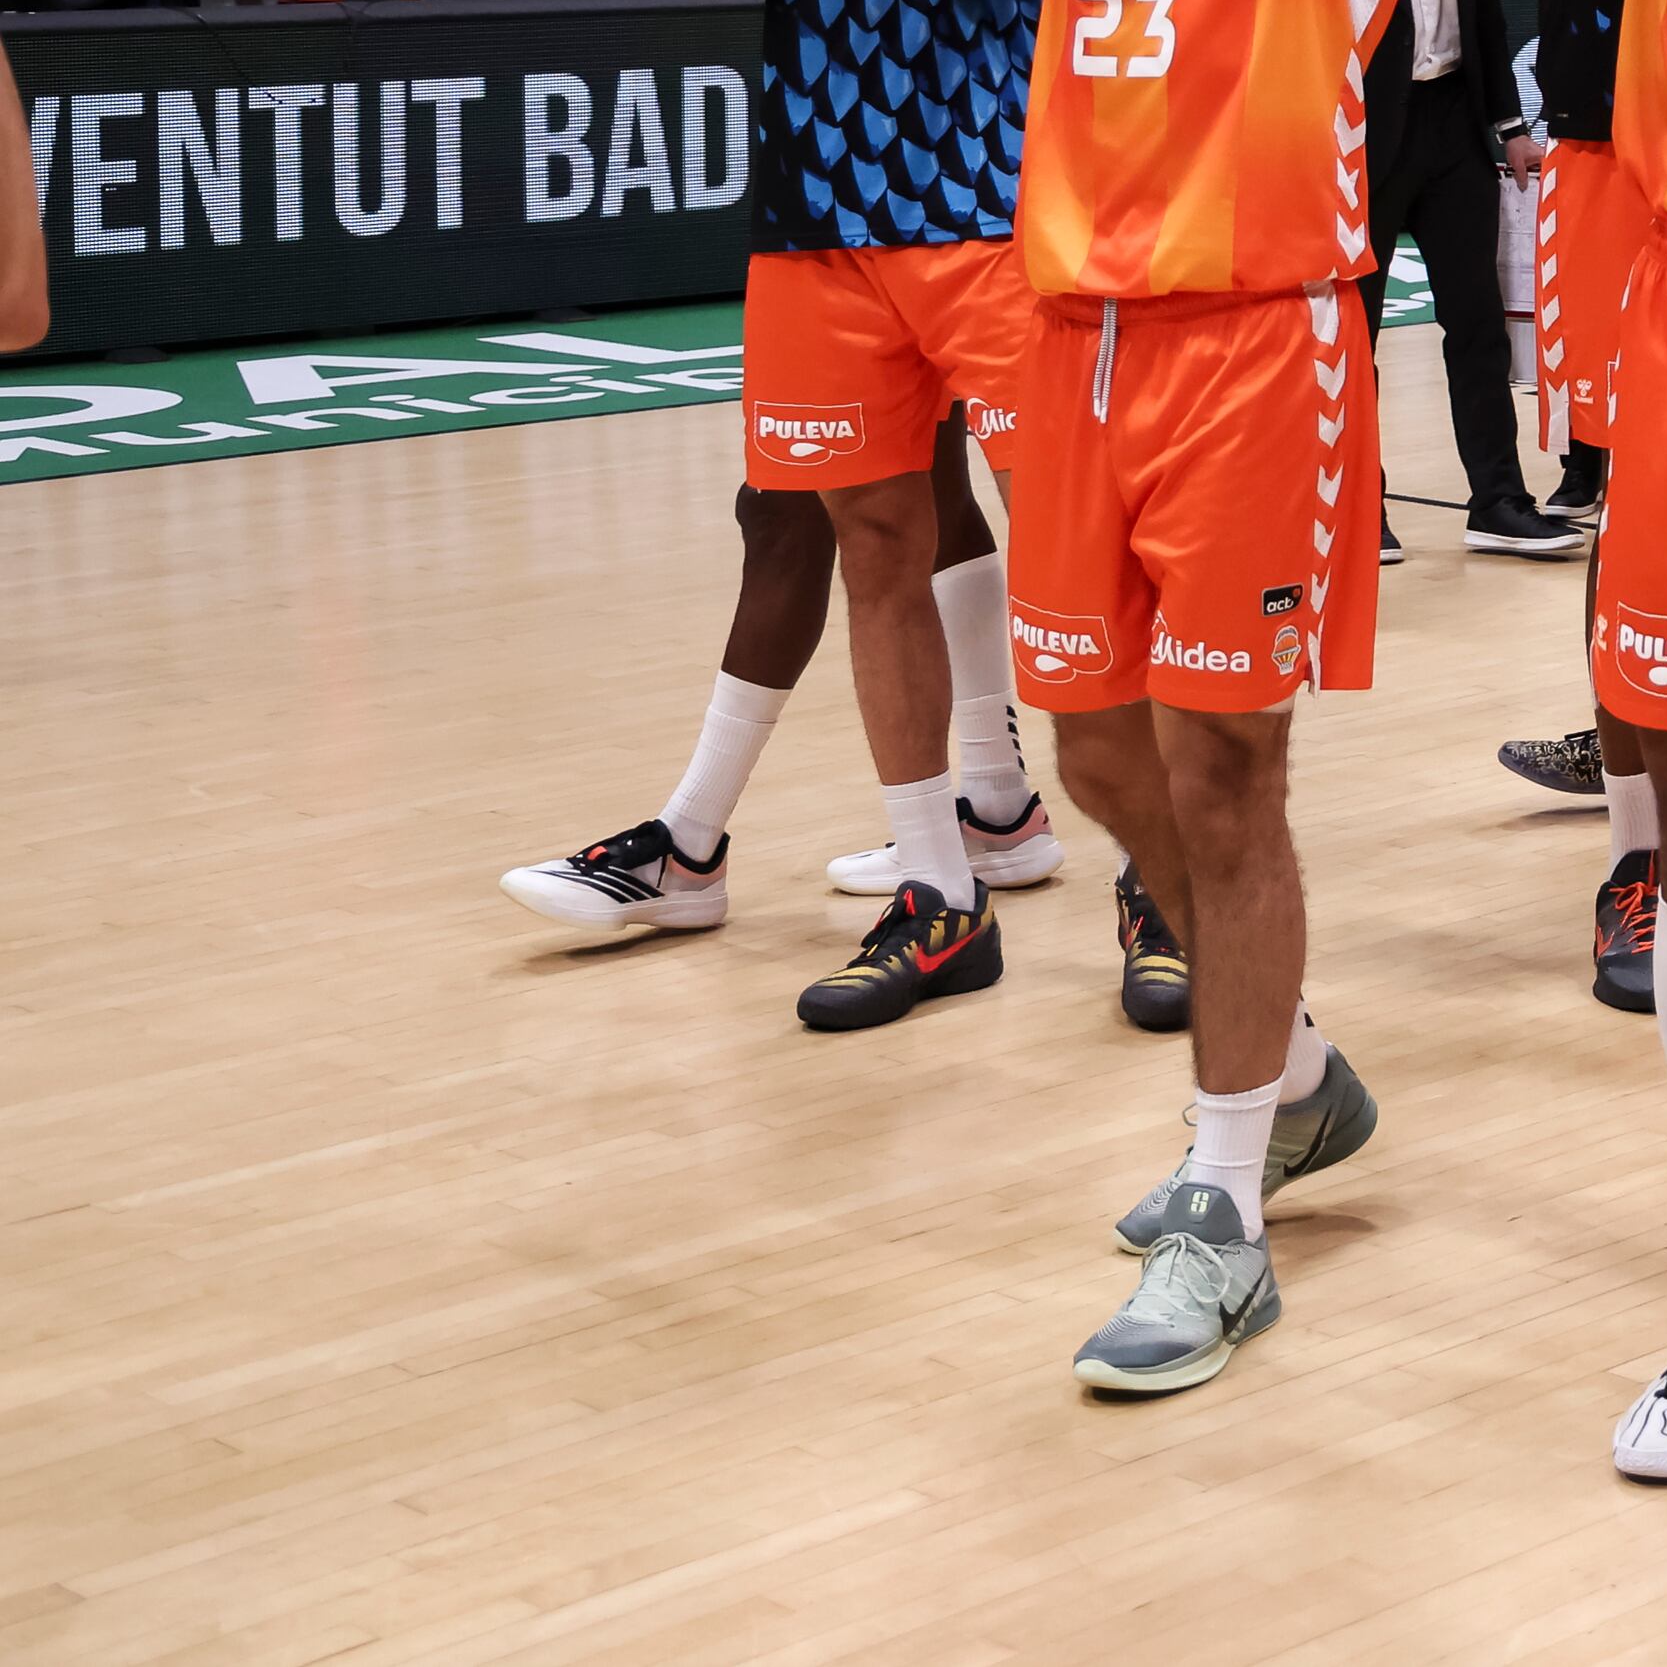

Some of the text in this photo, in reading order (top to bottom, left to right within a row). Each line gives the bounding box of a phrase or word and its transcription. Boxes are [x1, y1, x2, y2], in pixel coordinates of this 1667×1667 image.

[759, 415, 855, 441] PULEVA
[1265, 596, 1295, 614] acb
[1013, 615, 1101, 656] PULEVA
[1151, 631, 1251, 673] Midea
